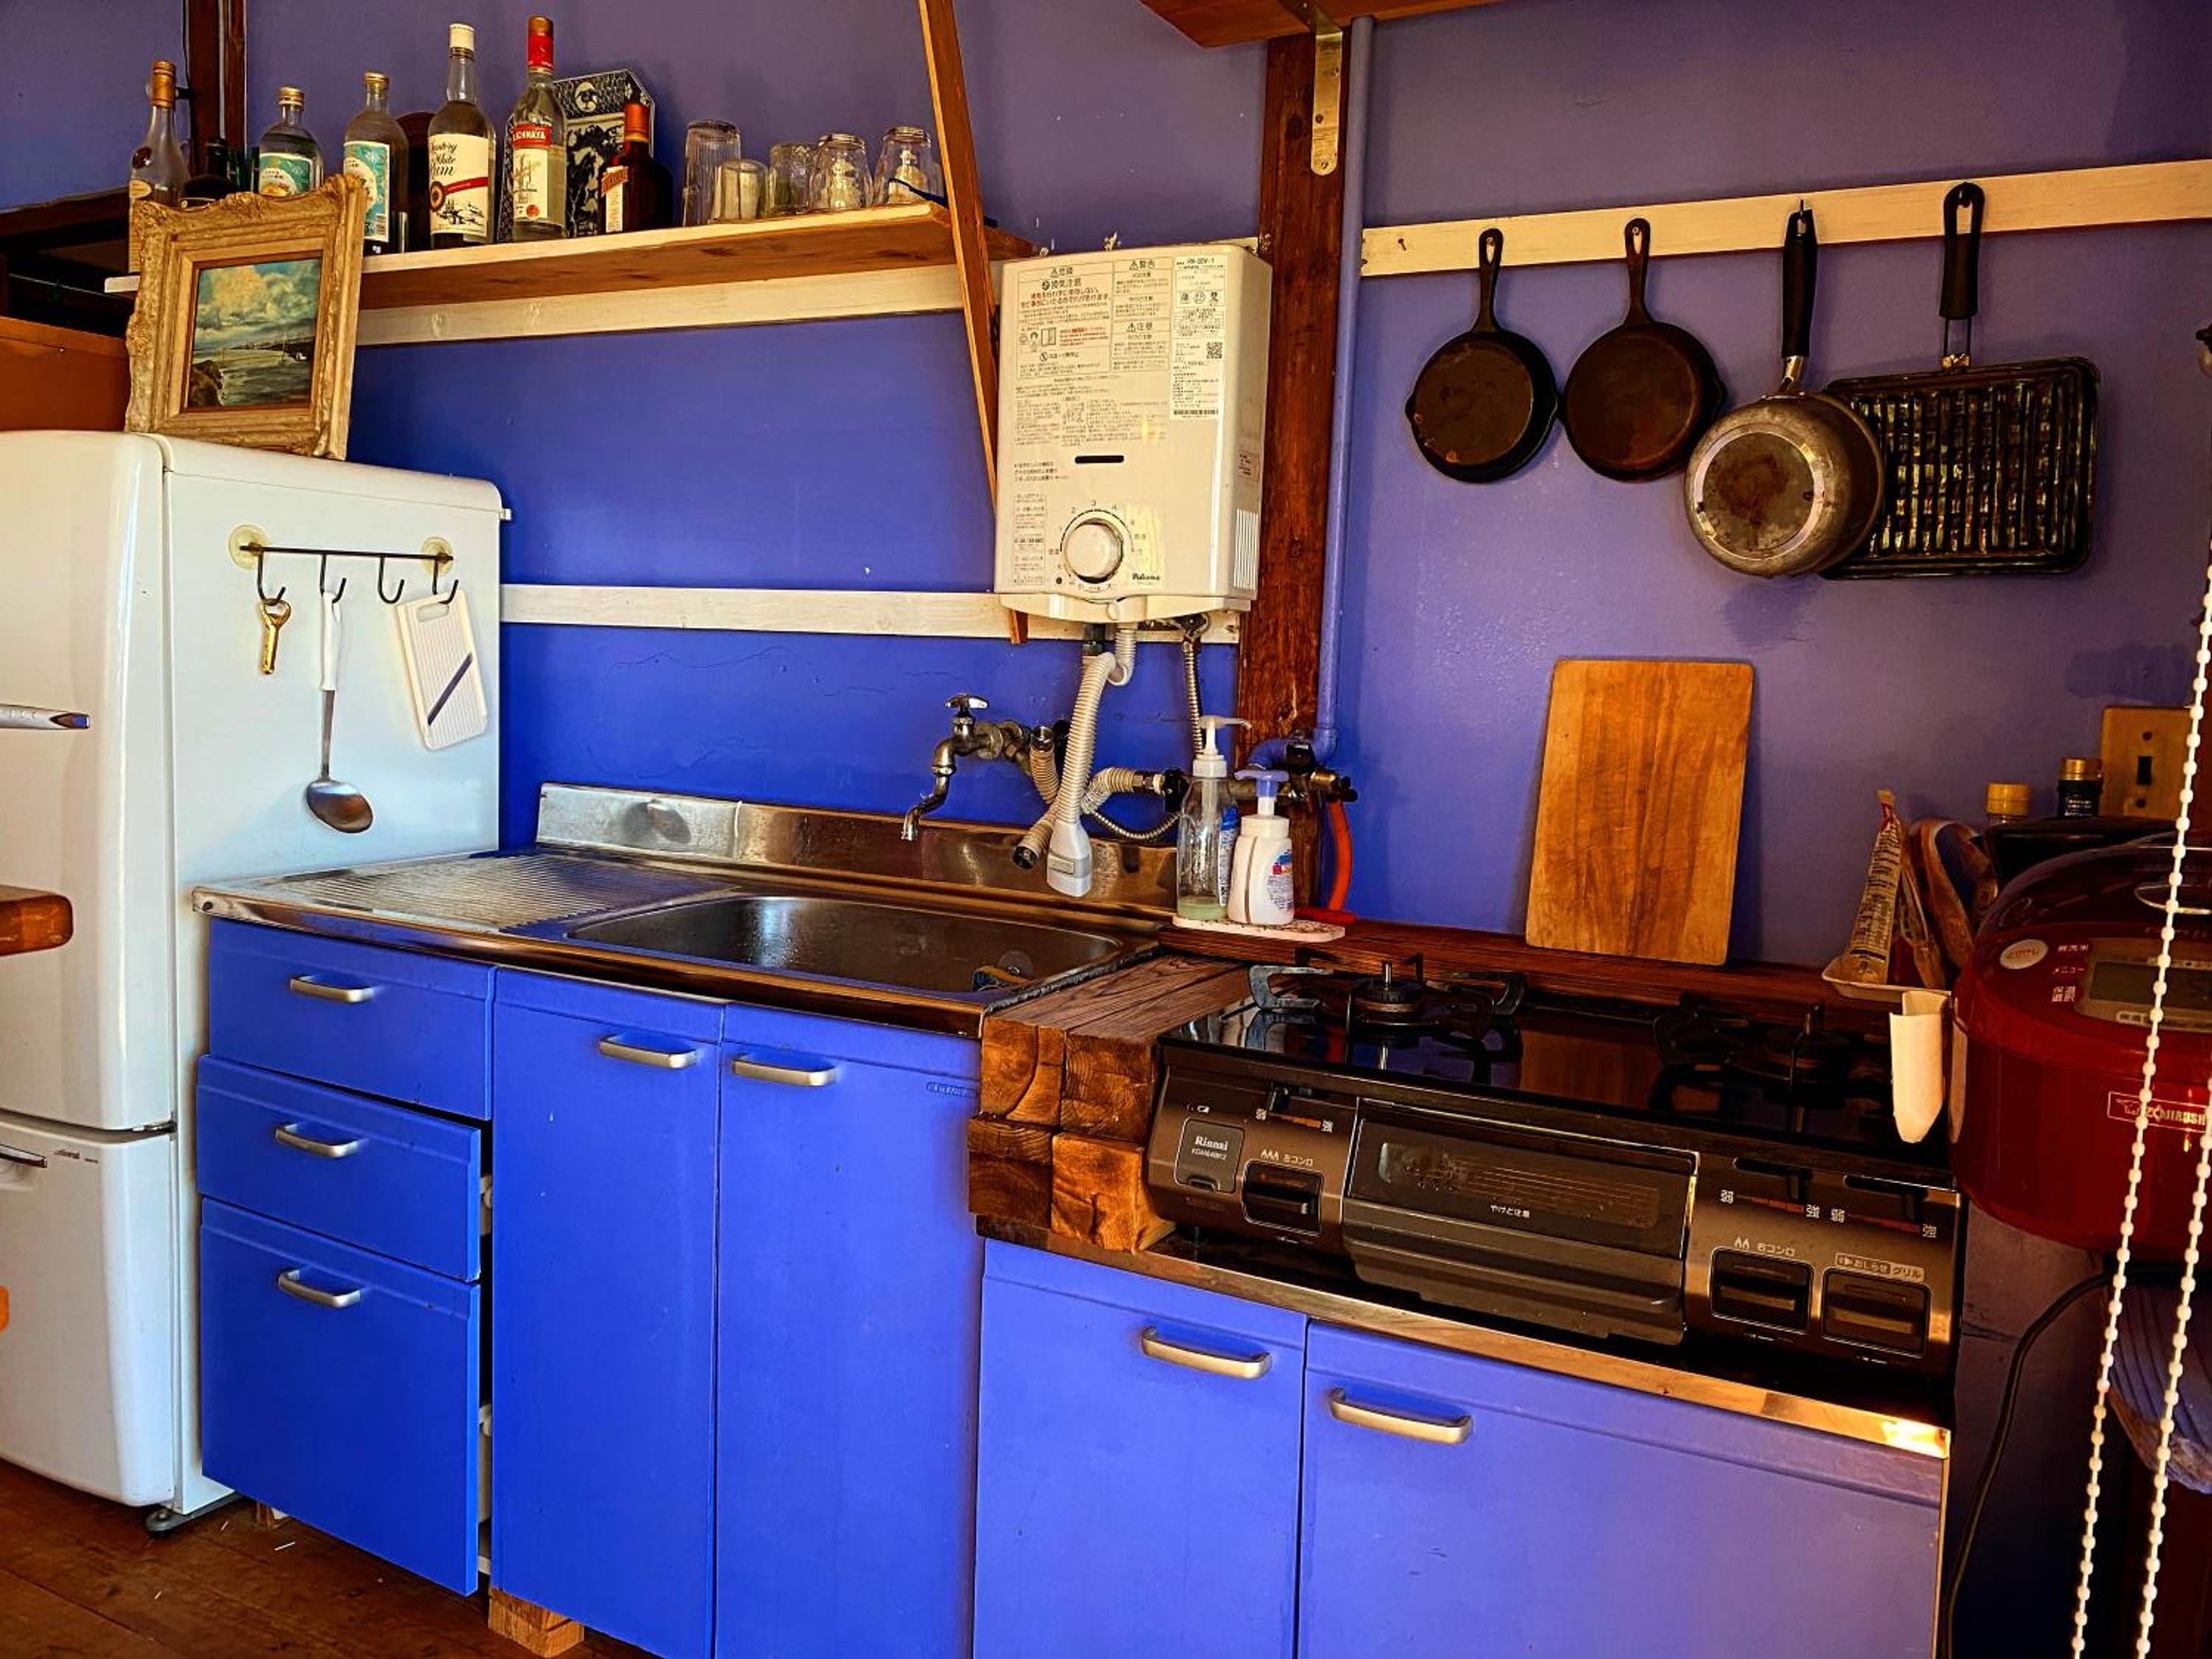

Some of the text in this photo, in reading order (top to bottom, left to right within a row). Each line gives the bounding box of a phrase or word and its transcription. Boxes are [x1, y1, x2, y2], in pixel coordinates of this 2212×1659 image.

[1194, 1135, 1228, 1151] Rinnai
[1720, 1189, 1733, 1203] 弱
[1806, 1204, 1820, 1219] 強
[1831, 1208, 1845, 1222] 弱
[1922, 1223, 1937, 1238] 強
